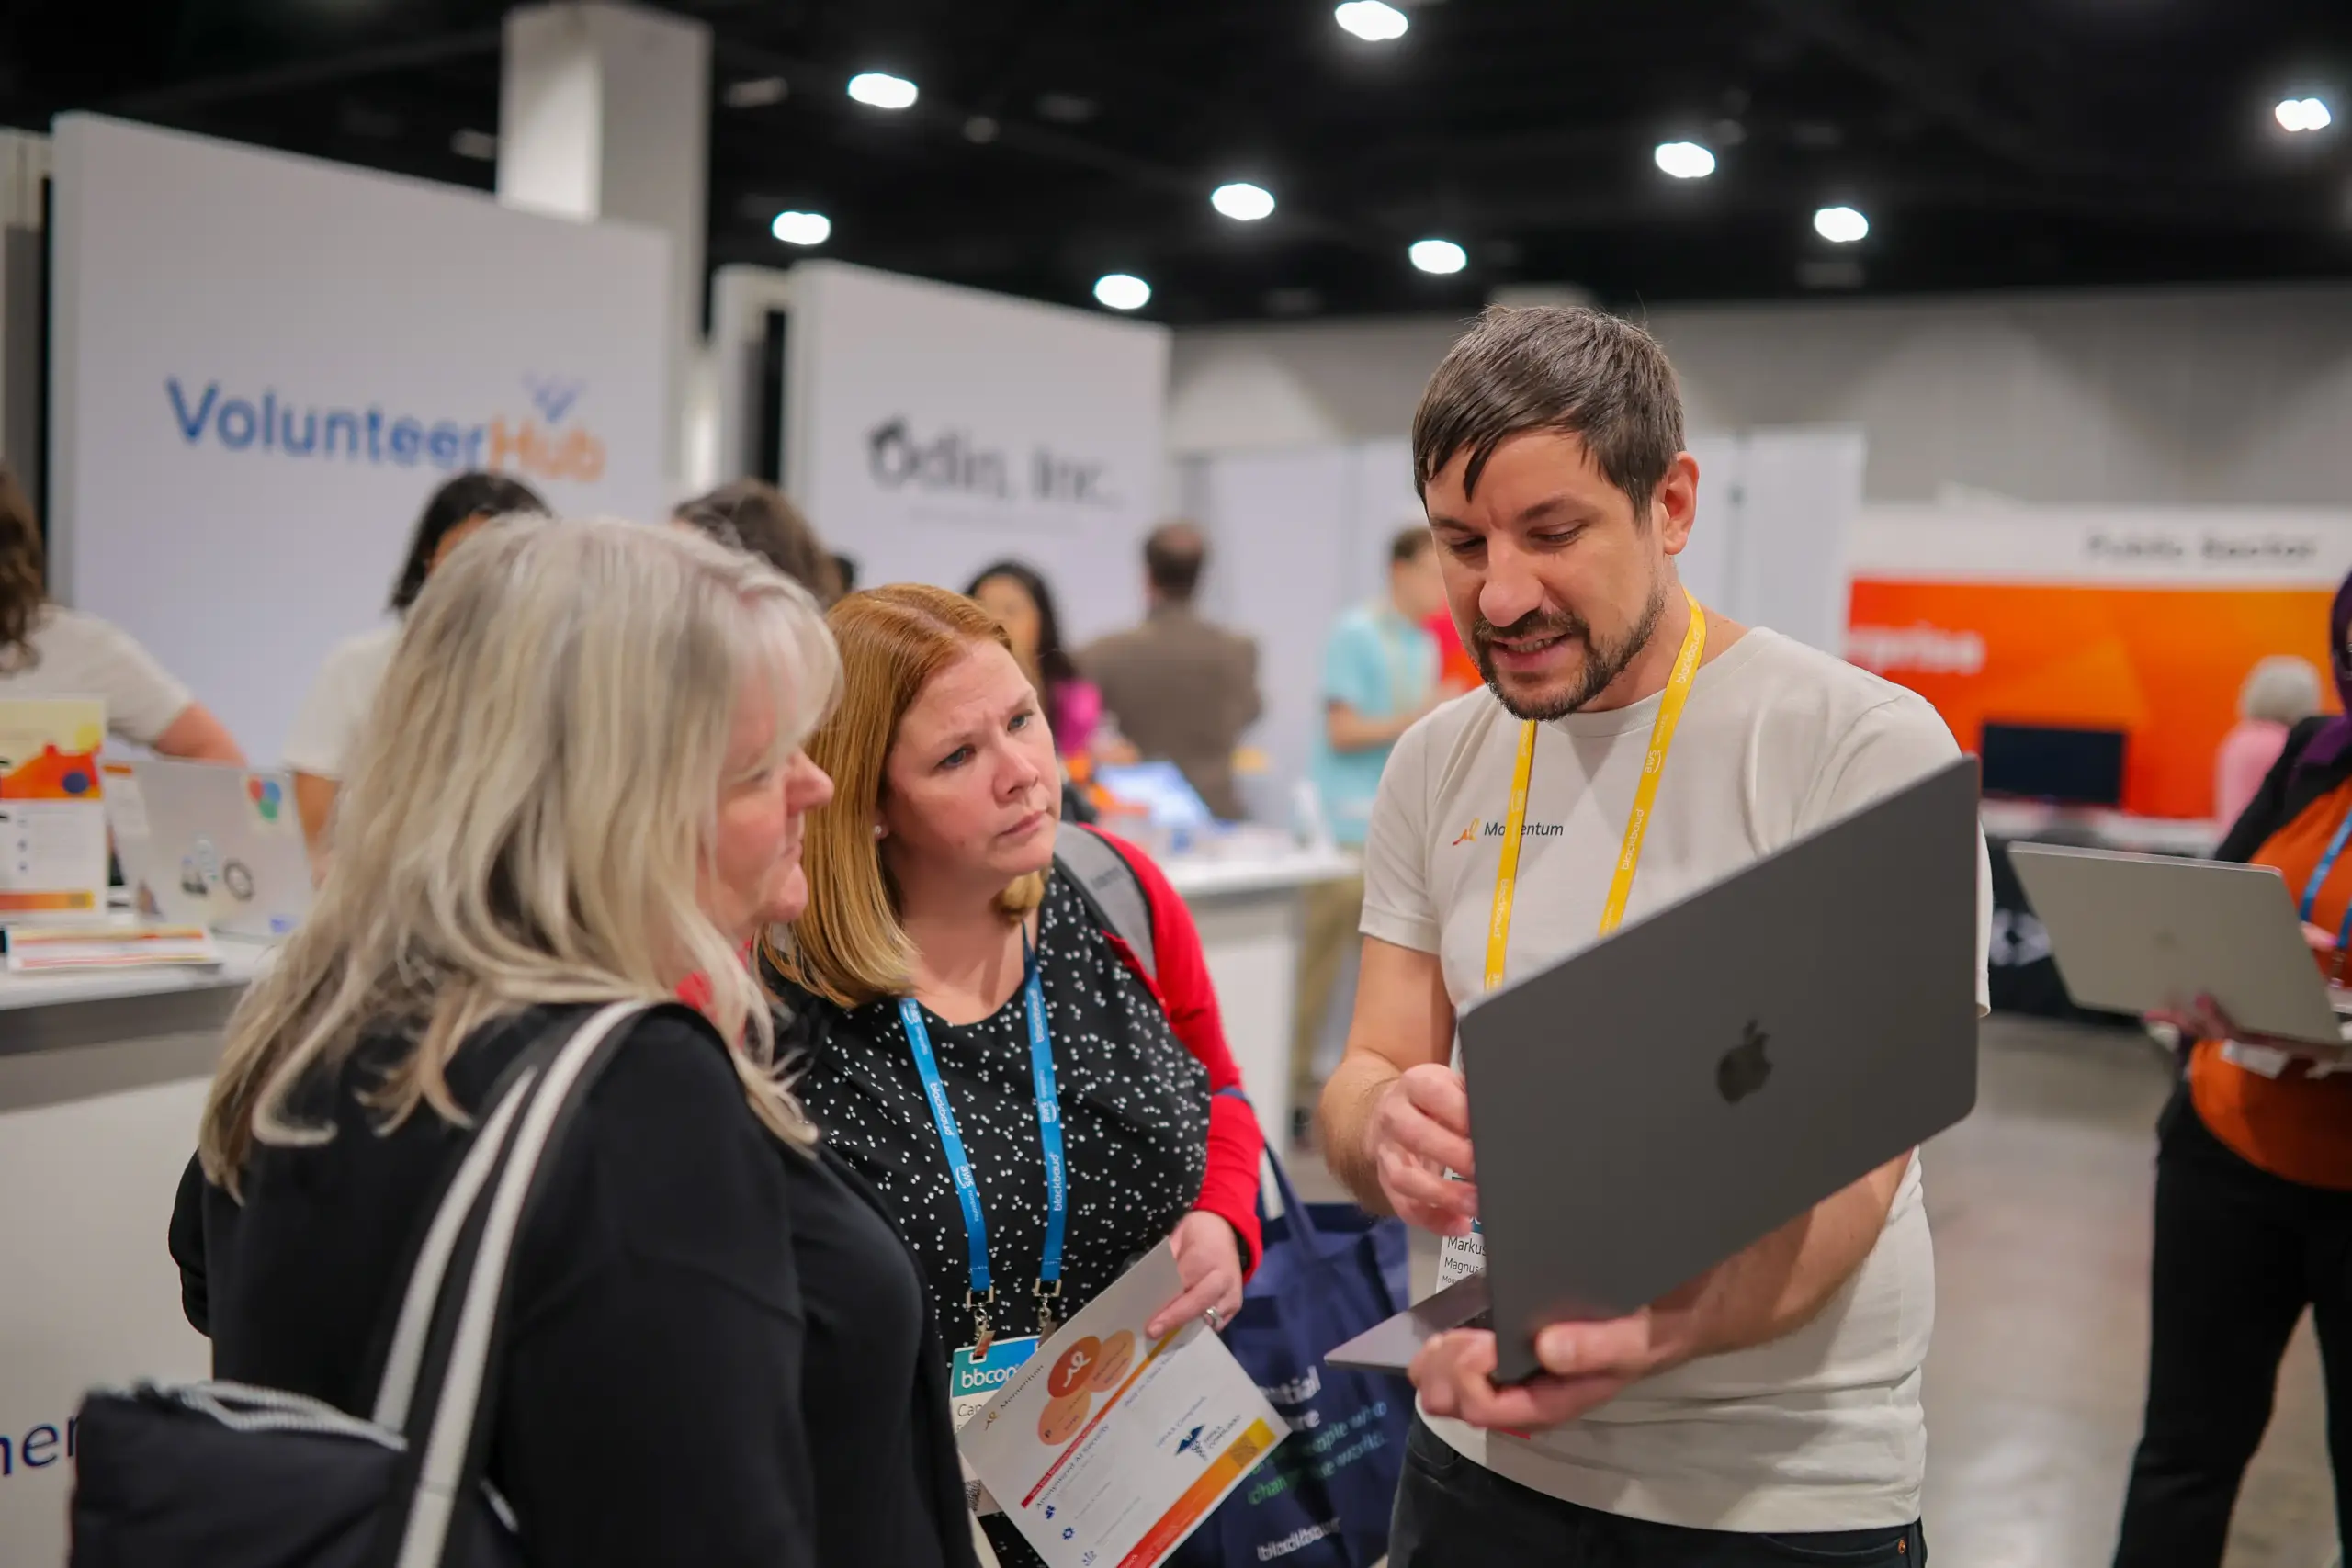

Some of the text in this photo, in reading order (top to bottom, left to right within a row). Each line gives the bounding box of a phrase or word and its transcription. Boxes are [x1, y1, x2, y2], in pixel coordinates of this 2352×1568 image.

[165, 373, 606, 483] VolunteerHub
[1678, 629, 1702, 685] blackbaud
[1644, 749, 1659, 774] aws
[1484, 821, 1565, 837] Moentum
[1622, 808, 1645, 870] blackbaud
[1493, 878, 1510, 939] blackbaud
[928, 1081, 956, 1138] blackbaud
[958, 1164, 975, 1189] aws
[1048, 1151, 1063, 1212] blackbaud
[1444, 1256, 1485, 1274] Magnus
[999, 1364, 1045, 1410] Momentum
